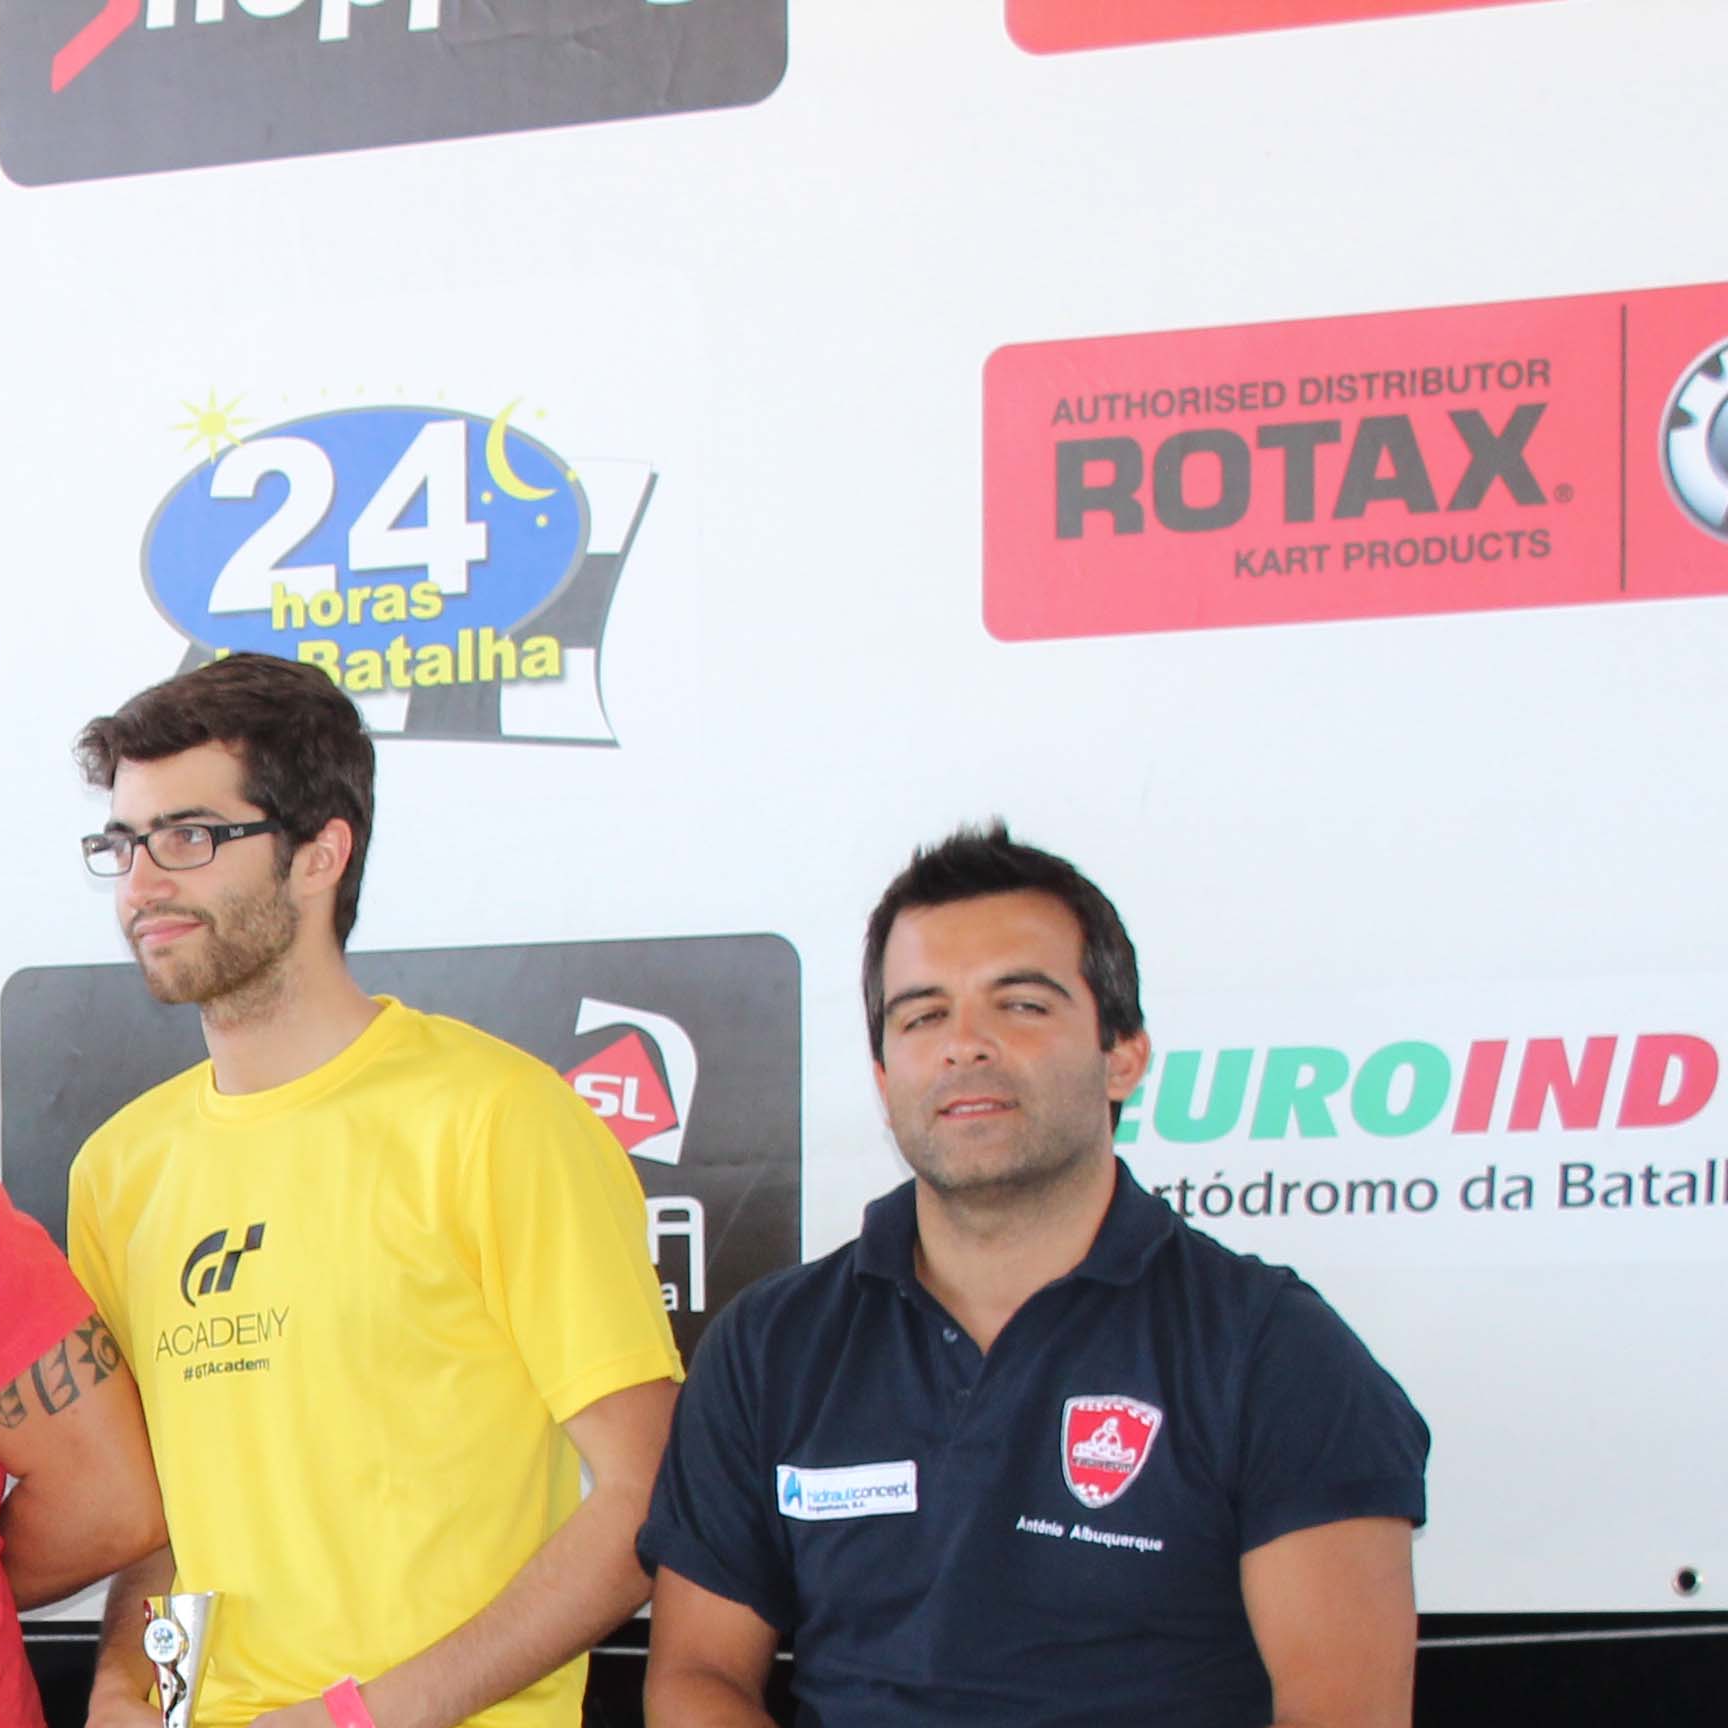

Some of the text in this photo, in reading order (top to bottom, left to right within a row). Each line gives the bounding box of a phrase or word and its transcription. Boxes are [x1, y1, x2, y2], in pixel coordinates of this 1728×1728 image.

[1052, 359, 1552, 426] AUTHORISED DISTRIBUTOR
[1054, 403, 1548, 540] ROTAX
[208, 418, 486, 614] 24
[1234, 529, 1552, 579] KART PRODUCTS
[270, 582, 442, 630] horas
[297, 627, 561, 692] Batalha
[573, 1072, 656, 1123] SL
[1114, 1033, 1719, 1145] UROIND
[1153, 1159, 1728, 1219] rtódromo da Batal
[1070, 1525, 1162, 1552] Albuquerque
